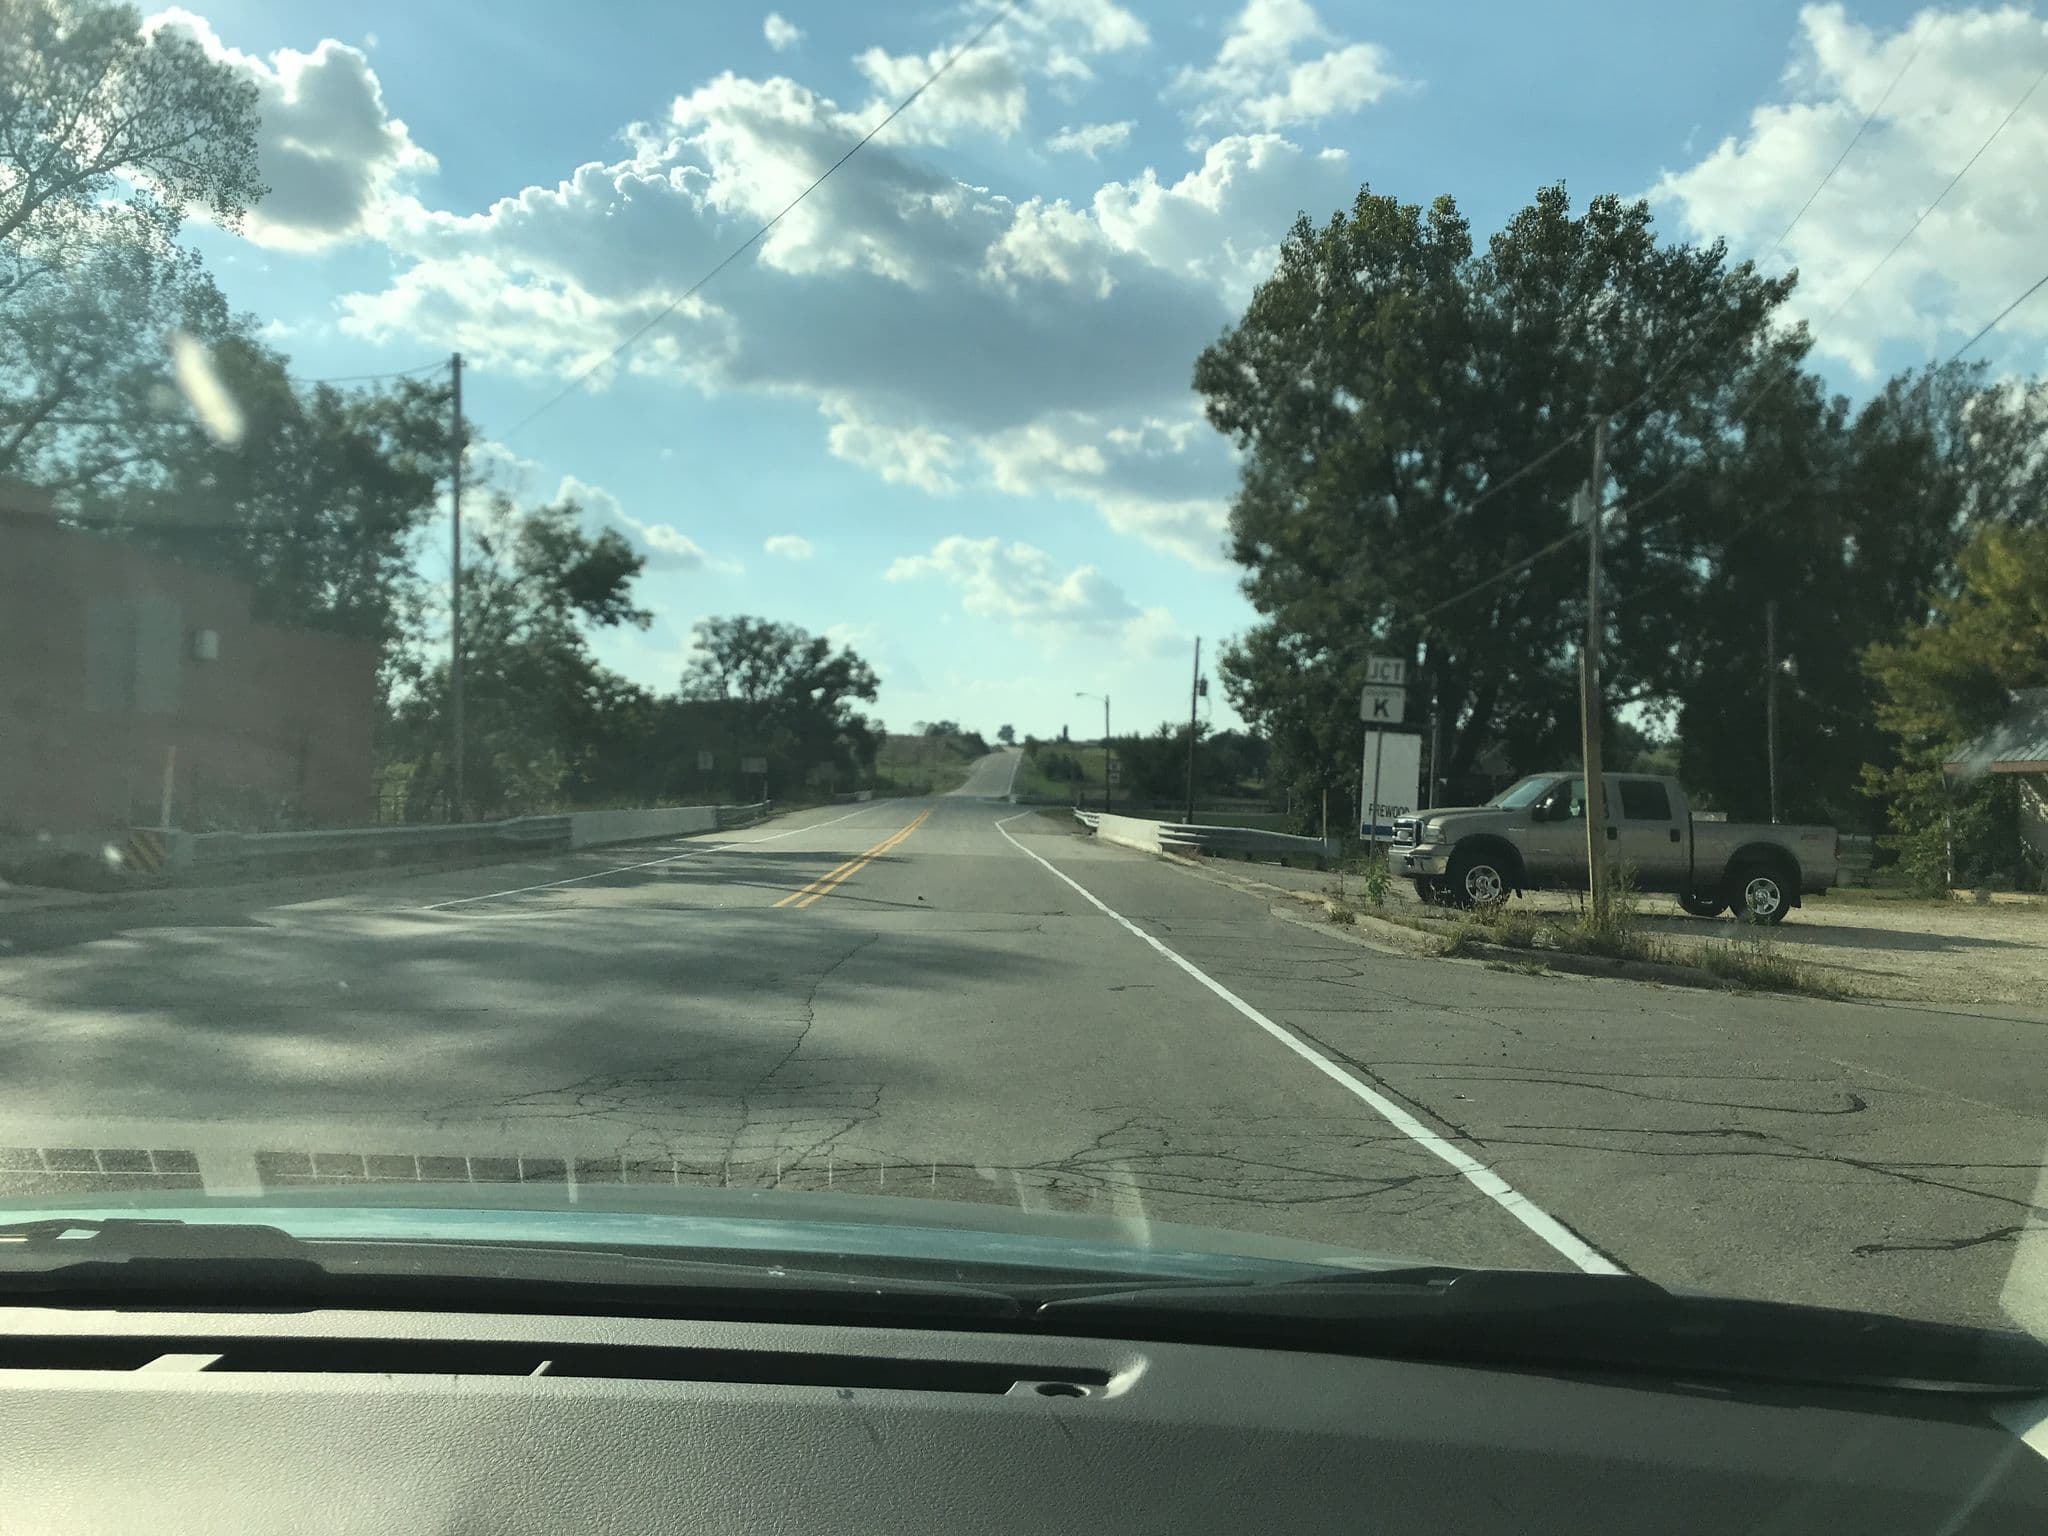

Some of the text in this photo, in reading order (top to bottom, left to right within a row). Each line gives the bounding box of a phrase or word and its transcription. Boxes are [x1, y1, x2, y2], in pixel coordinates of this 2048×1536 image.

[1370, 662, 1402, 681] JCT
[1373, 699, 1389, 718] K
[1368, 802, 1410, 818] FREWOO
